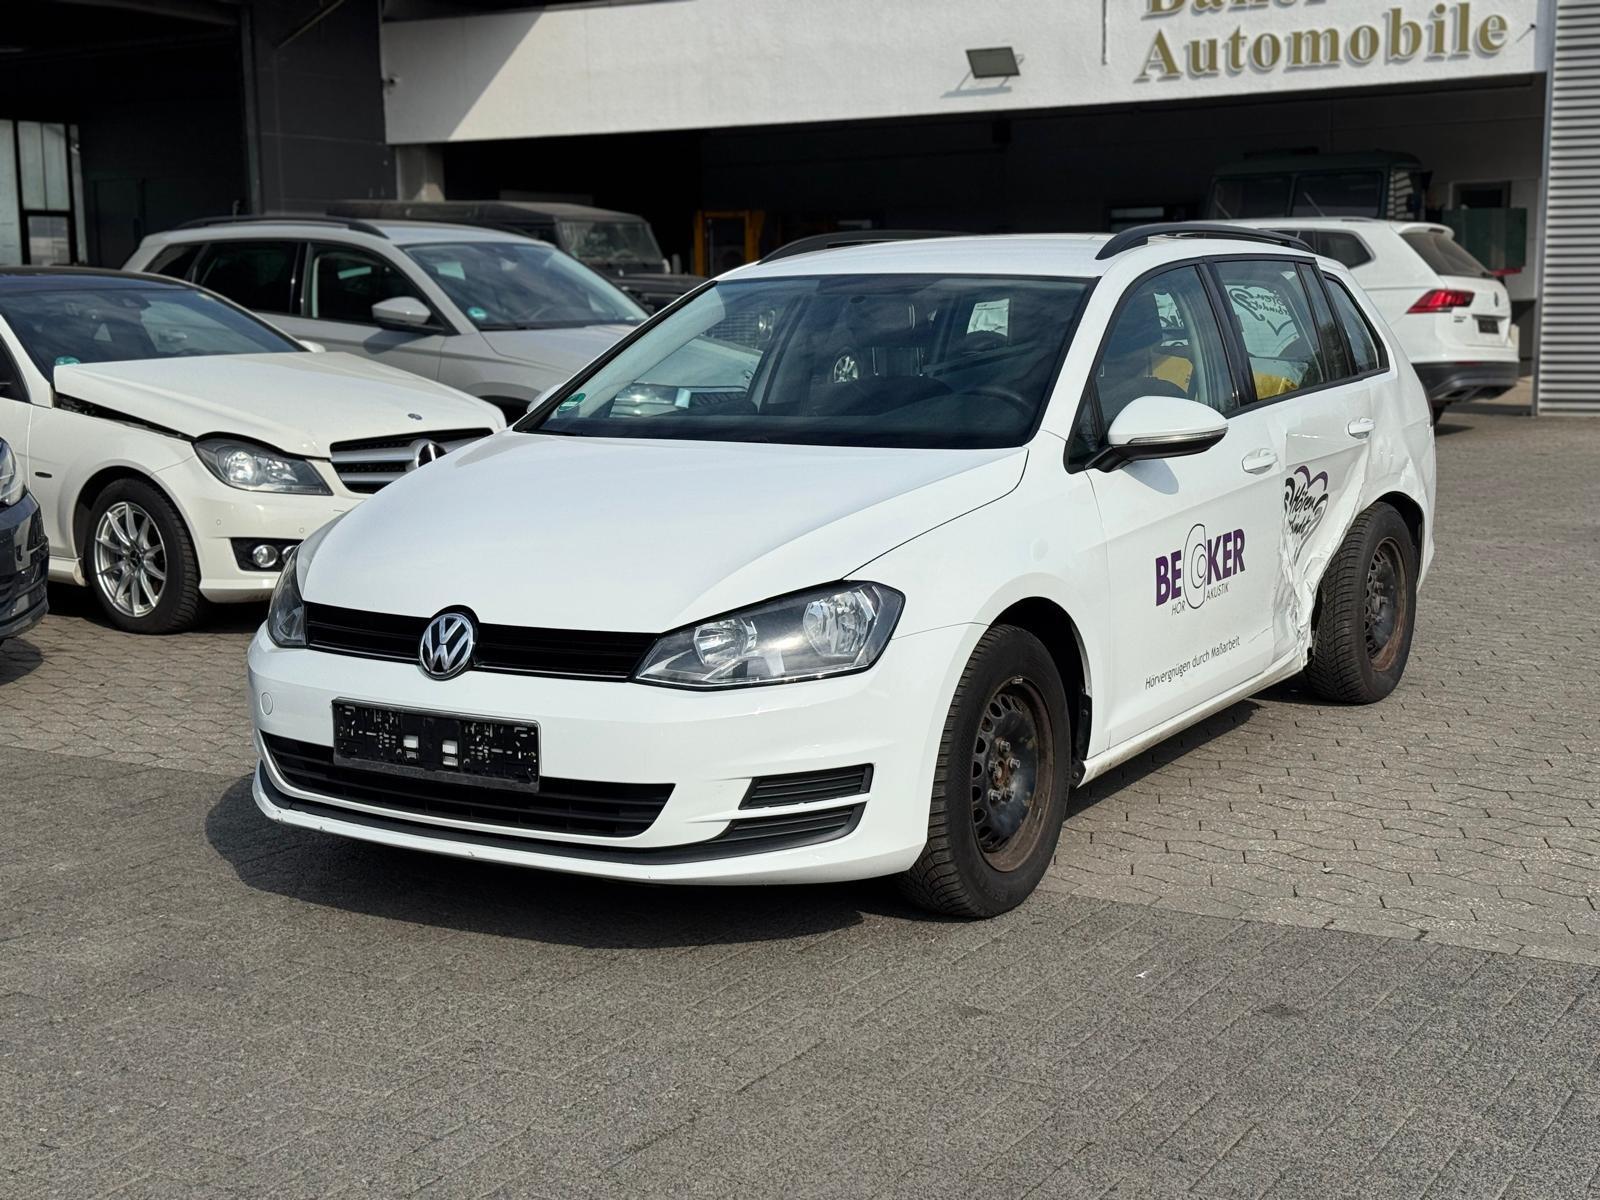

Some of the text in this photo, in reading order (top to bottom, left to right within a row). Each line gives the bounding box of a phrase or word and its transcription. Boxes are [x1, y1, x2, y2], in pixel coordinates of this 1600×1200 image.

[1134, 2, 1508, 82] Automobile
[1206, 582, 1230, 602] AKUSTIK
[423, 614, 472, 676] VW
[1145, 635, 1241, 690] Hörvergnügen durch Maßarbeit
